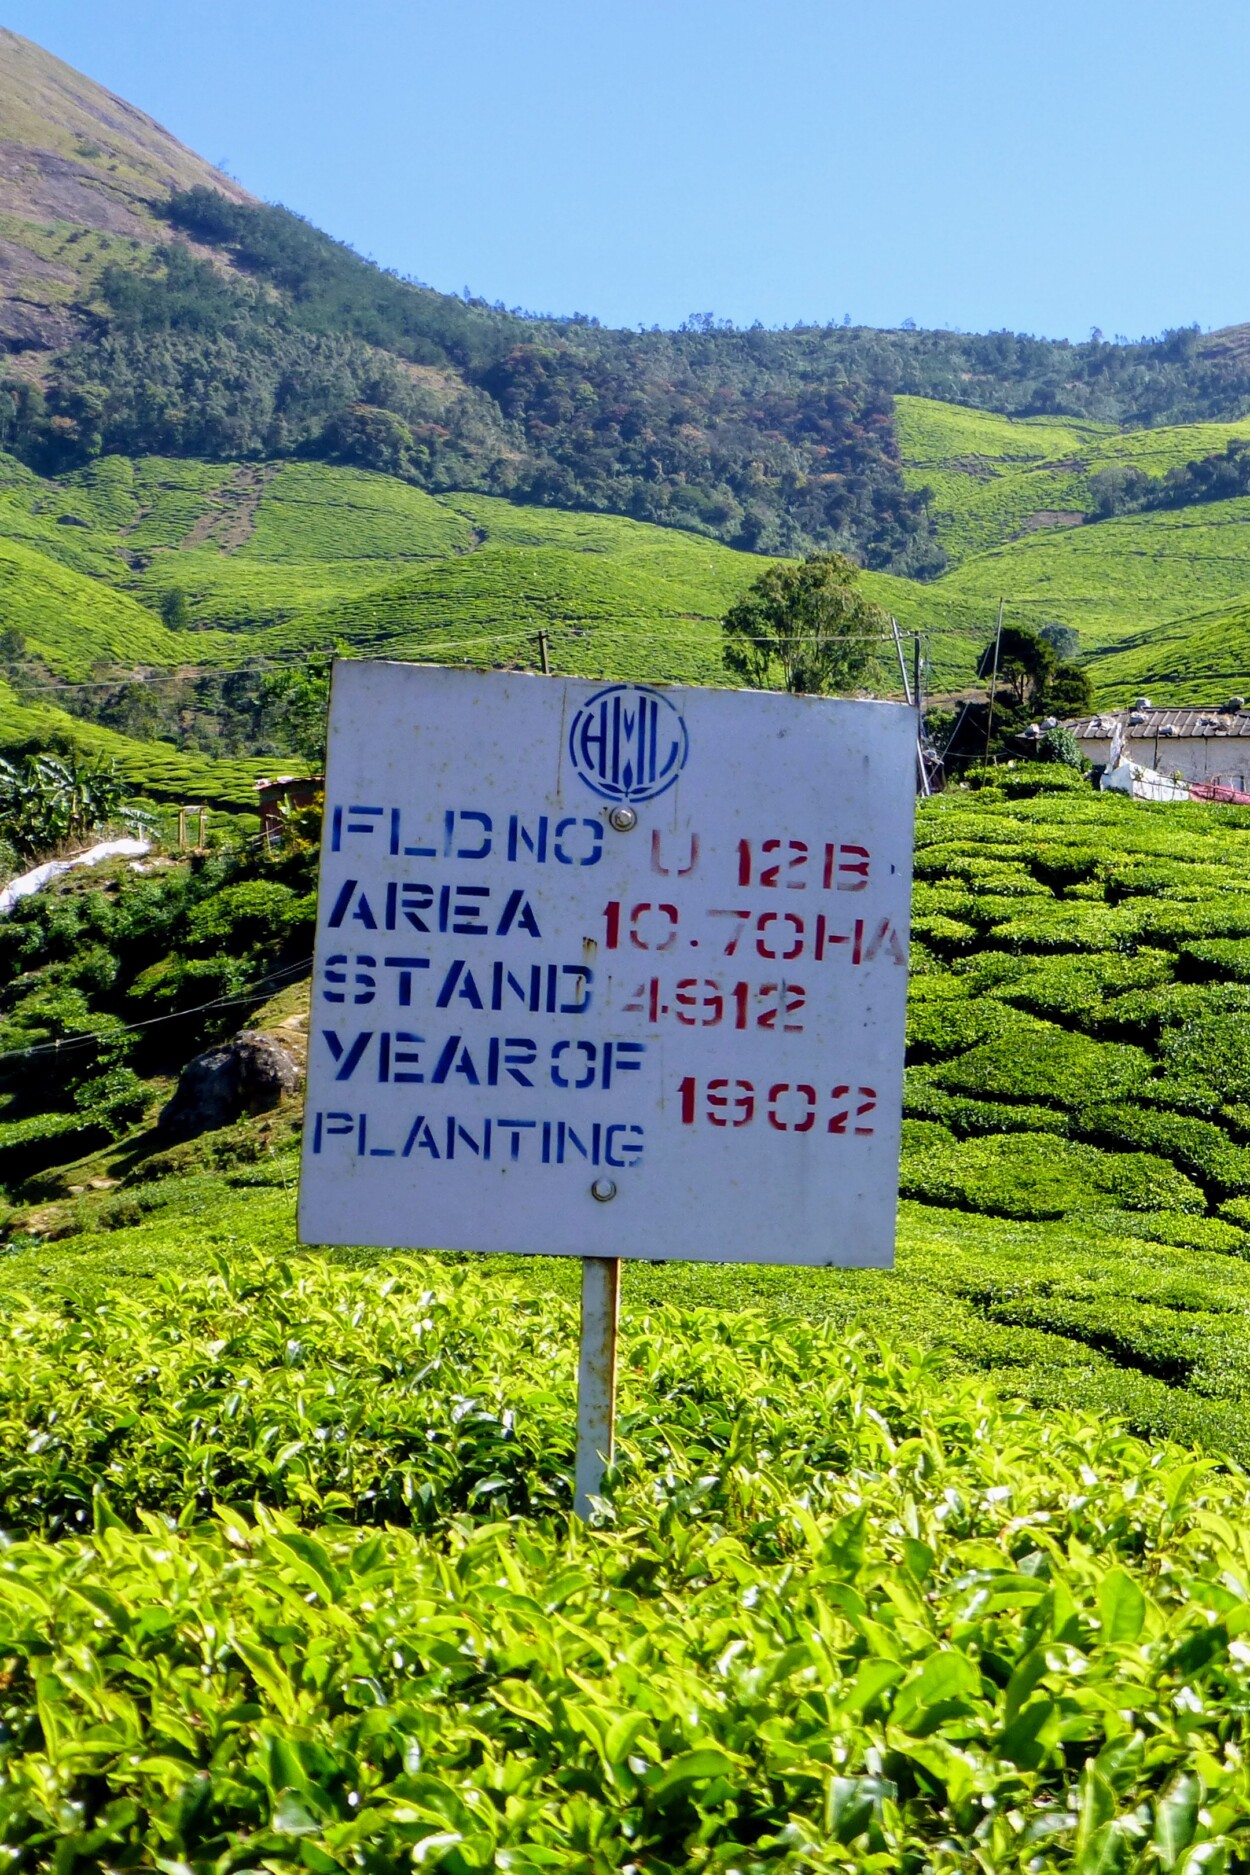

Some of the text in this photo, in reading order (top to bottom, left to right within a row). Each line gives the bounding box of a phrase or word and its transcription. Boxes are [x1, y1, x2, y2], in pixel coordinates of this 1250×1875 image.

[580, 696, 679, 788] HML
[650, 829, 699, 876] U
[738, 838, 871, 891] 12B
[328, 879, 541, 938] AREA
[323, 954, 806, 1032] STAND 4912
[322, 1030, 647, 1090] YEAR OF
[679, 1076, 877, 1136] 1902
[313, 1112, 644, 1167] PLANTING
